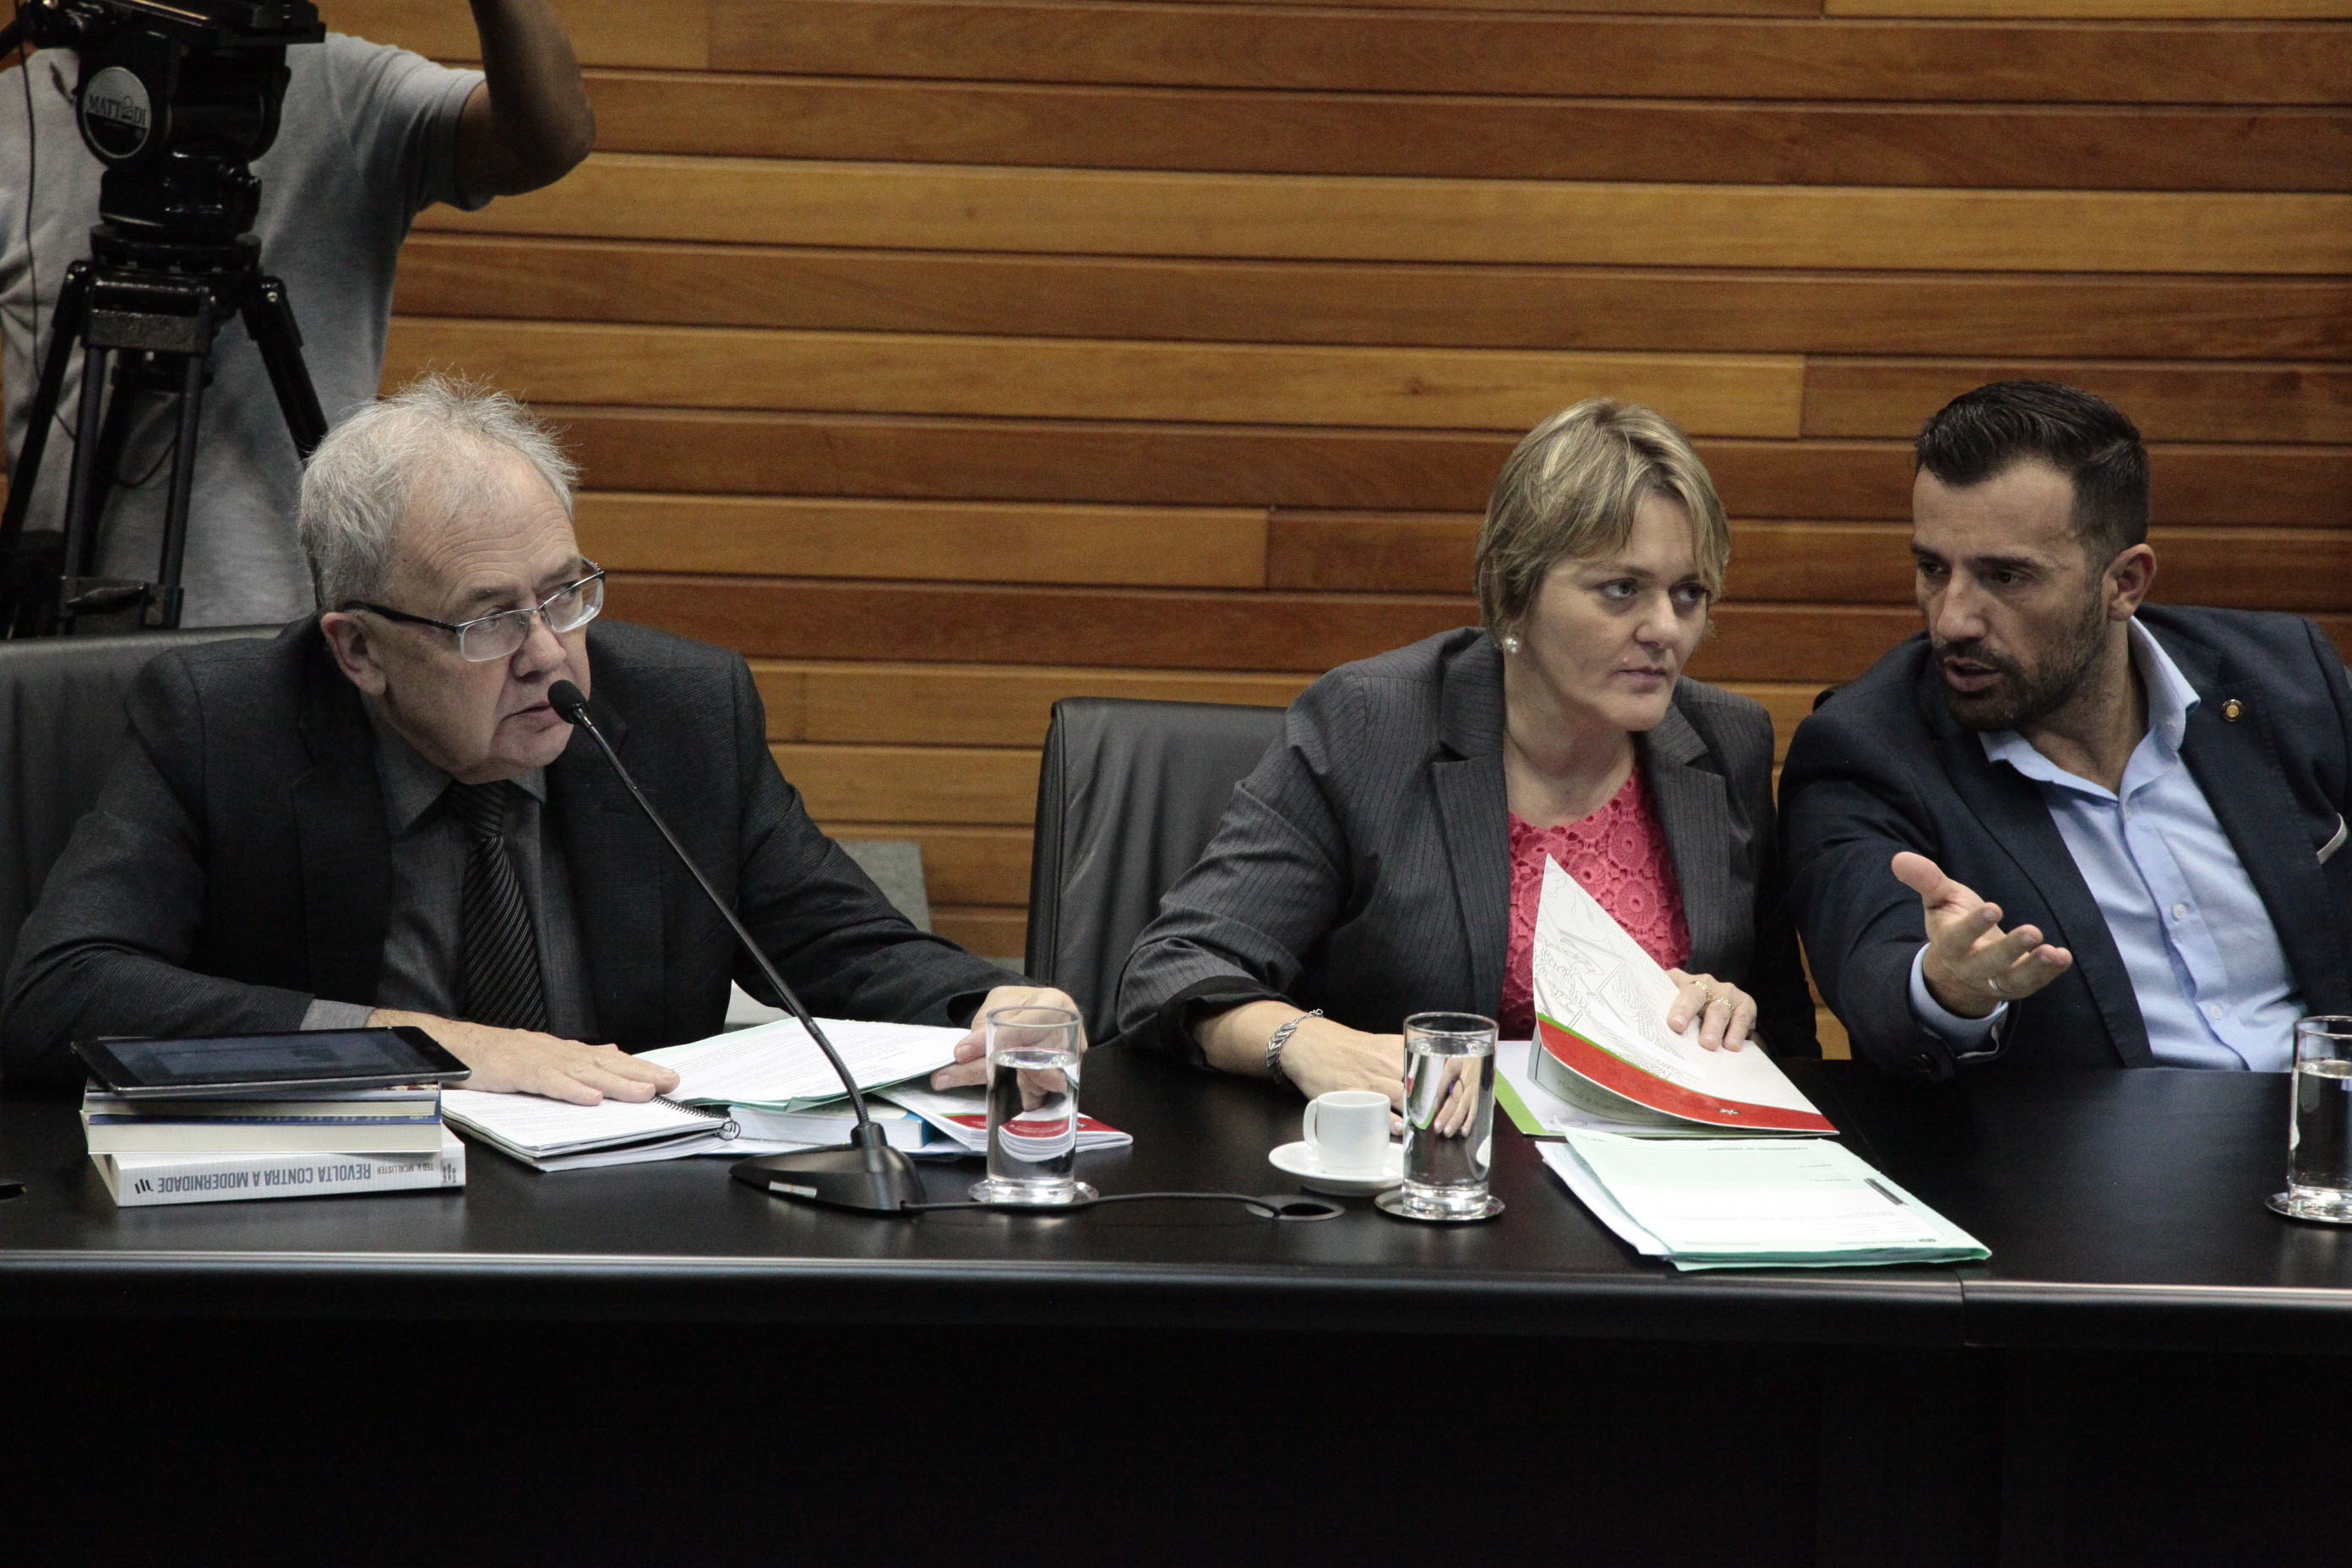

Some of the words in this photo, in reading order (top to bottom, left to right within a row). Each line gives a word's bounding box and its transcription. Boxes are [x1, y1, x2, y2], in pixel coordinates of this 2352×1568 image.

[264, 1168, 313, 1185] CONTRA
[318, 1163, 371, 1182] REVOLTA
[377, 1165, 414, 1174] MCALLISTER
[157, 1172, 248, 1193] MODERNIDADE
[253, 1171, 261, 1186] A
